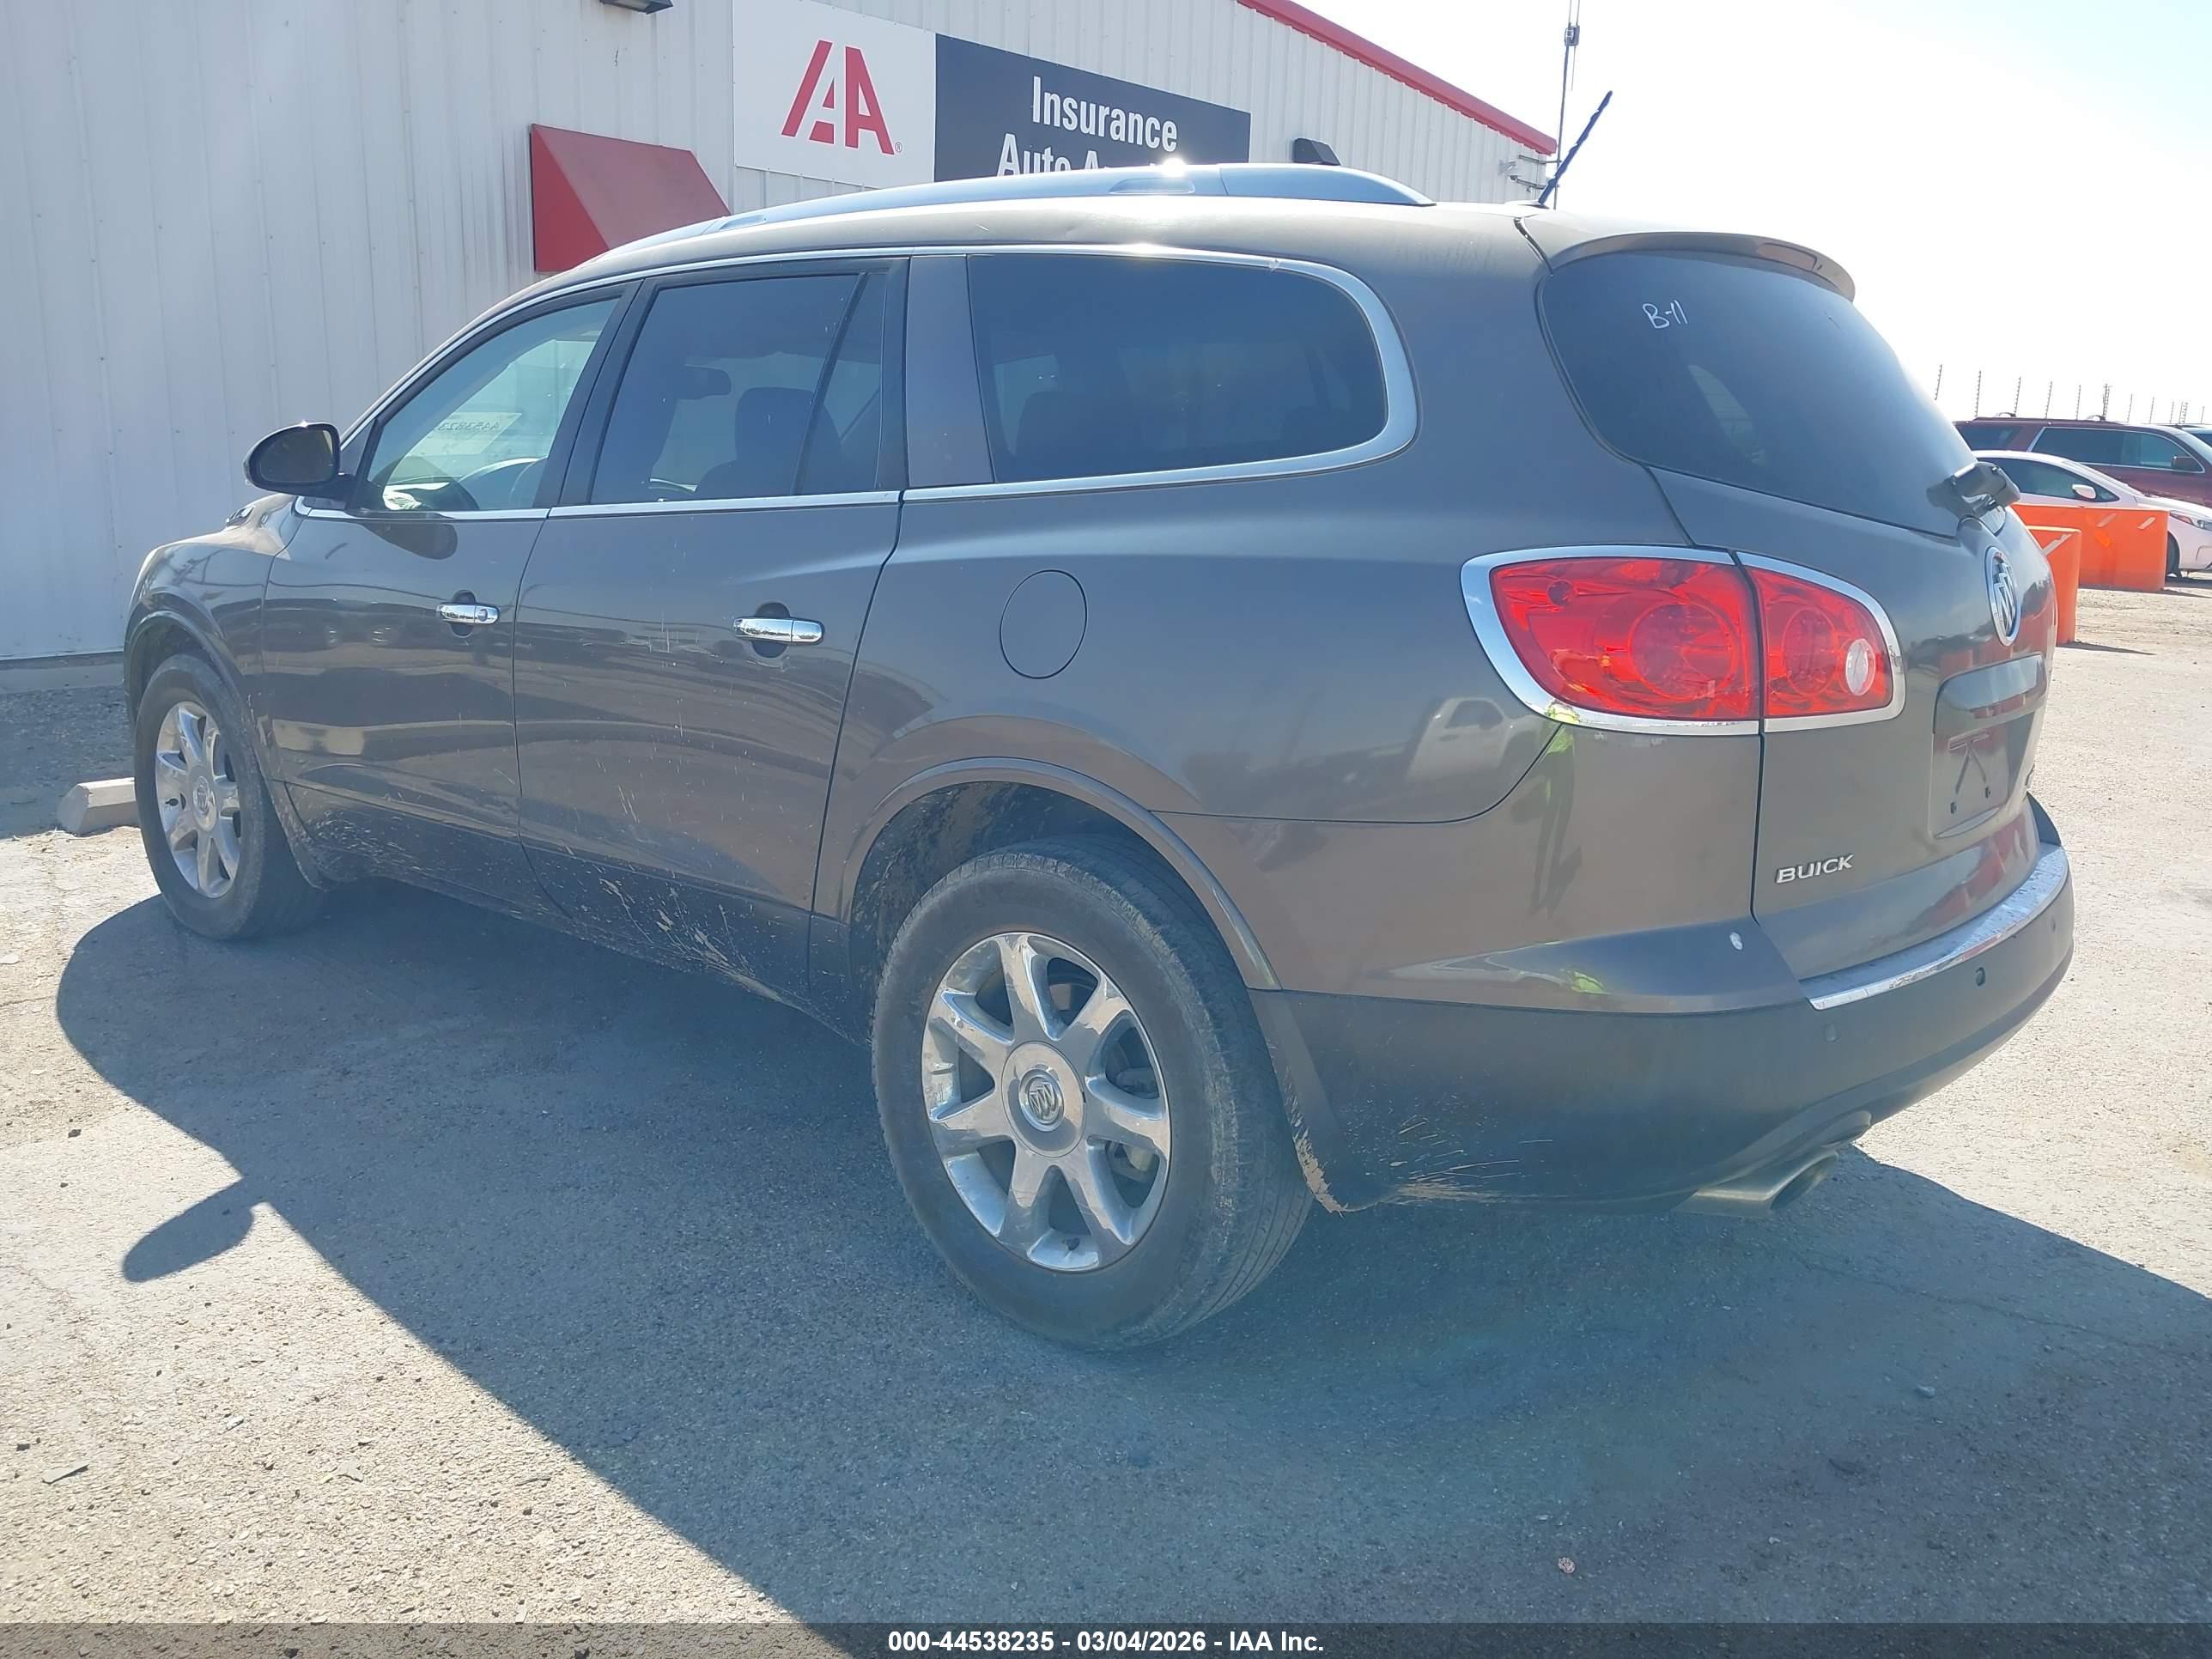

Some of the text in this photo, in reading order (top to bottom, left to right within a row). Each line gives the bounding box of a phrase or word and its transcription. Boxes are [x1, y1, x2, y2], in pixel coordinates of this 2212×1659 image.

[1032, 76, 1177, 152] Insurance
[1642, 300, 1688, 329] B-11
[1775, 854, 1854, 884] BUICK
